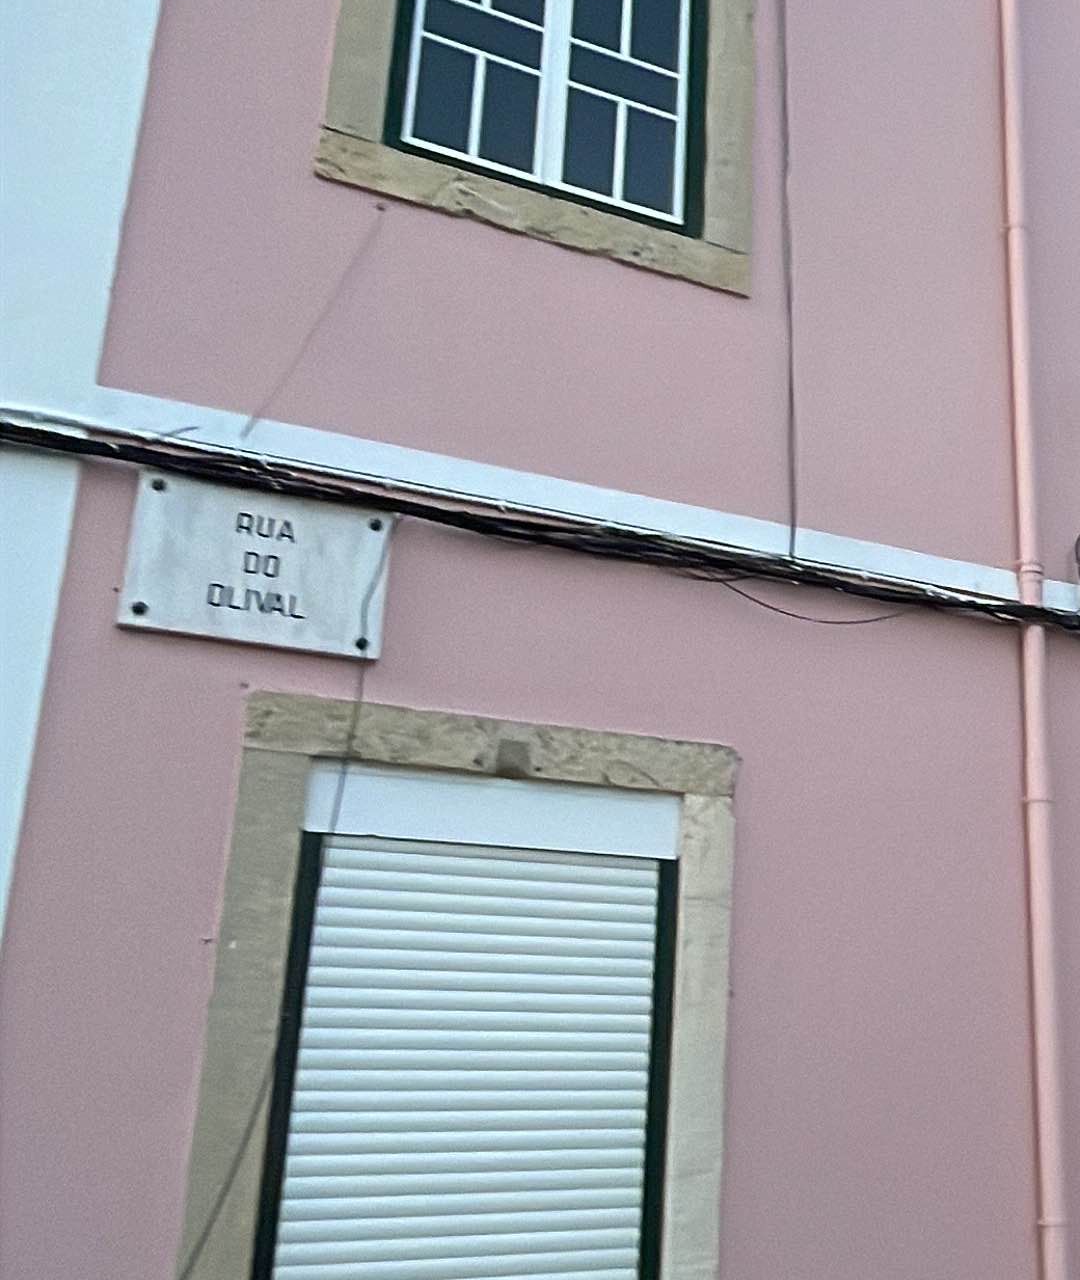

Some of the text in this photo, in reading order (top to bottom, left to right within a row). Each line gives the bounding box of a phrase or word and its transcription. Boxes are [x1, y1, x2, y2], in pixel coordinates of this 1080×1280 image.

[236, 511, 296, 544] RUA
[243, 551, 281, 578] DO
[206, 582, 306, 620] OLIVAL
